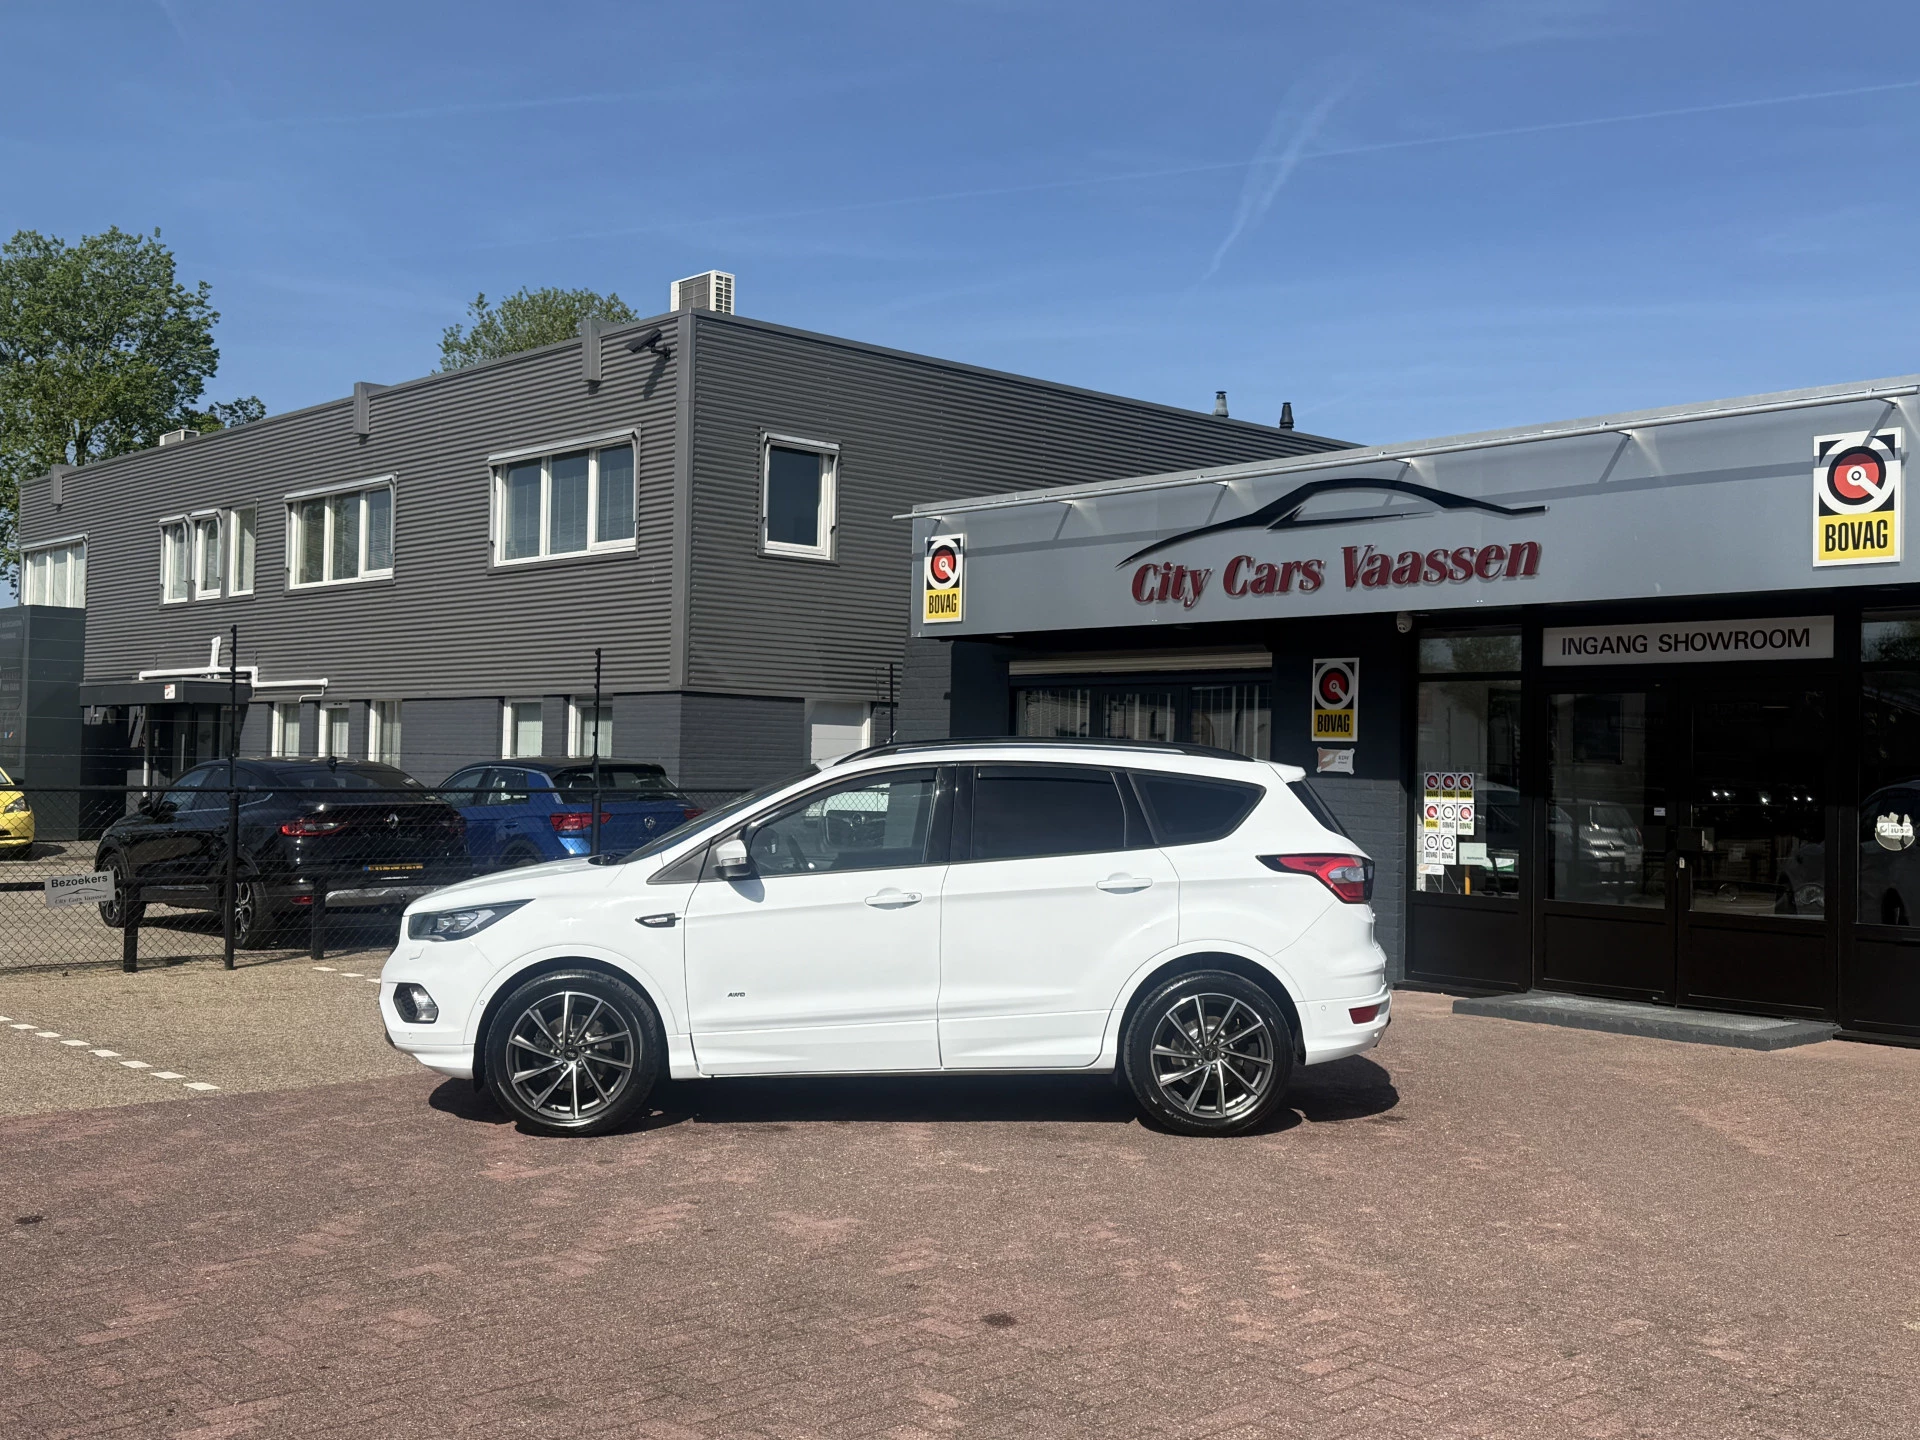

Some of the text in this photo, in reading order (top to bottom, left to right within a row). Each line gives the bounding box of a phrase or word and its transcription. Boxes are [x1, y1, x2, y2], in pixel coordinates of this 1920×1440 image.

[1825, 519, 1888, 552] BOVAG
[1131, 540, 1540, 609] City Cars Vaassen
[928, 593, 957, 614] BOVAG
[1561, 628, 1811, 656] INGANG SHOWROOM
[1317, 713, 1350, 733] BOVAG
[1442, 821, 1455, 829] BOVAG
[1459, 822, 1472, 830] BOVAG
[51, 875, 108, 888] Bezoekers
